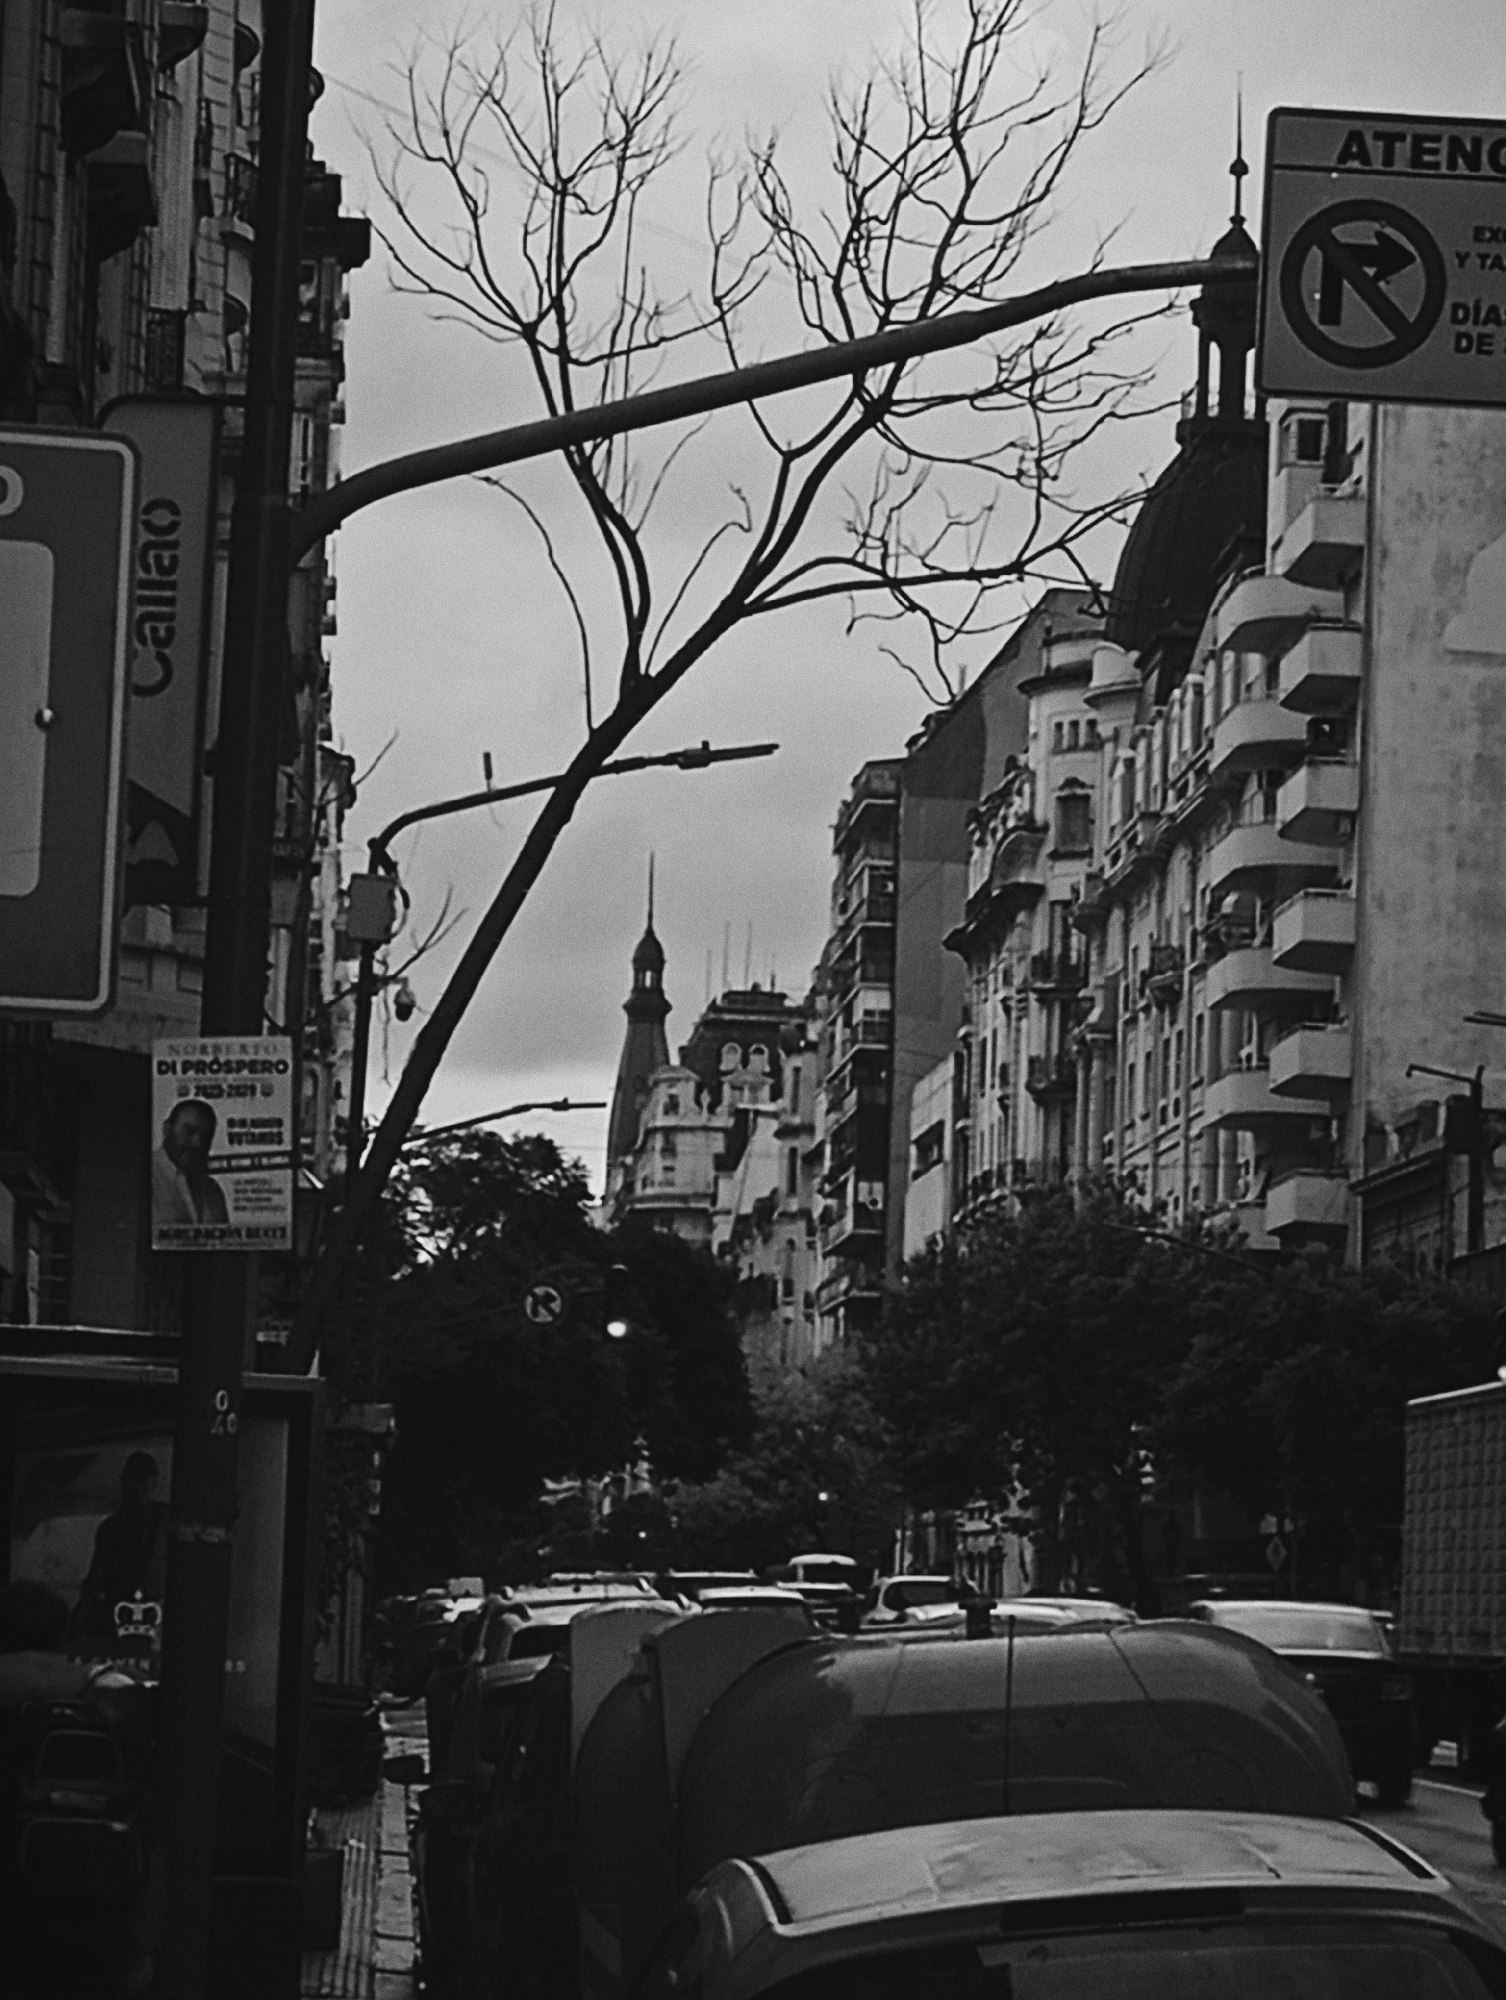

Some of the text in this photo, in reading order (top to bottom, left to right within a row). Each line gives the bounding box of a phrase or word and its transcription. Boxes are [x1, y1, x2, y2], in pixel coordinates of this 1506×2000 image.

[1473, 226, 1506, 243] EX
[1455, 251, 1506, 272] Y TA
[1450, 298, 1506, 327] DÍA
[1454, 332, 1494, 356] DE
[131, 497, 182, 697] Callao
[167, 1043, 278, 1056] NORBERTO
[157, 1056, 289, 1075] DI PRÓSPERO
